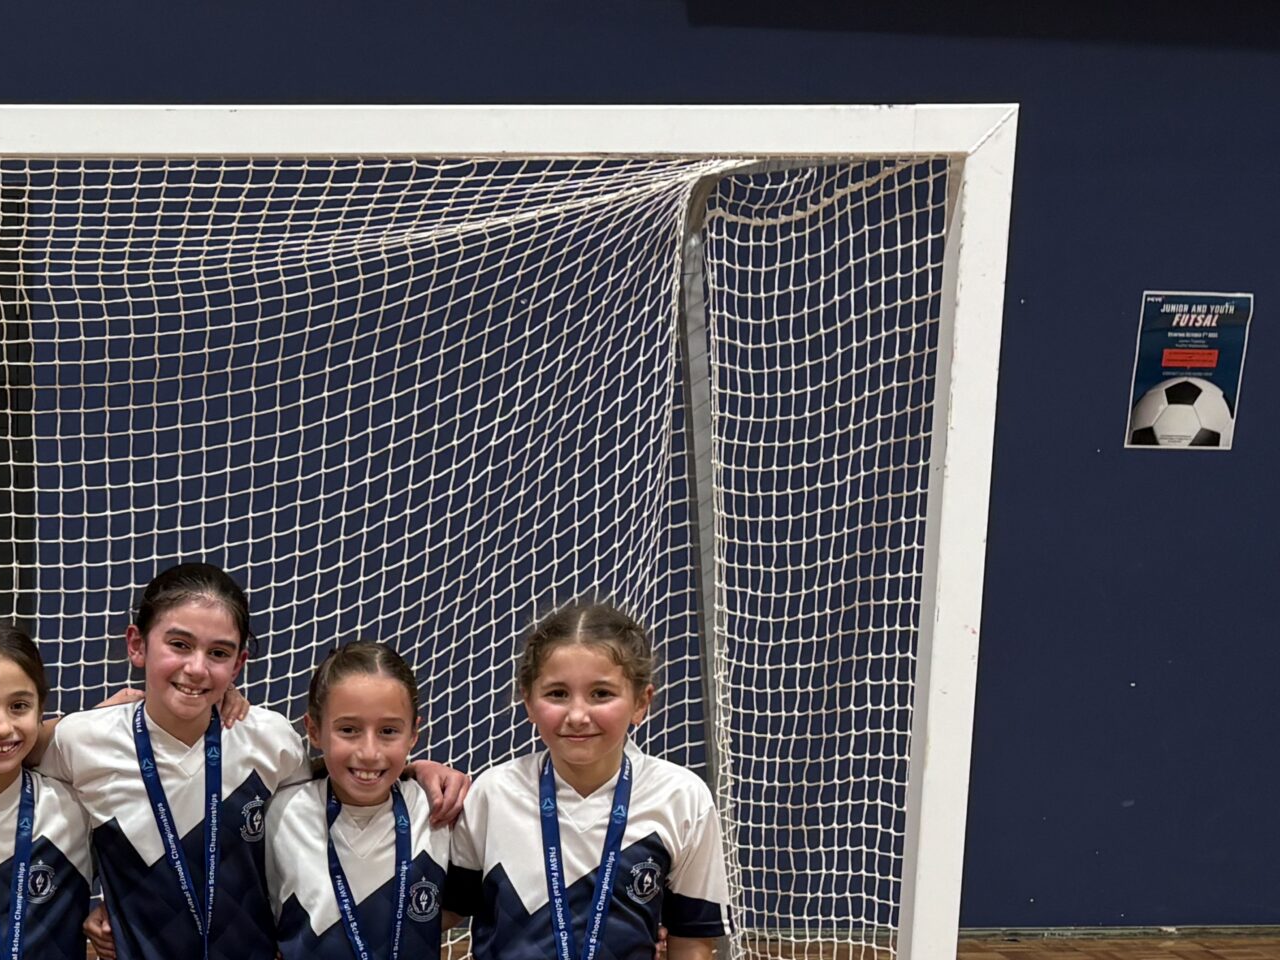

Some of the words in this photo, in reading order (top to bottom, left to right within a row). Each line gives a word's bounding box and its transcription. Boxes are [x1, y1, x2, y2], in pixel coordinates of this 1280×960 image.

[1160, 304, 1189, 313] JUNIOR
[1191, 305, 1207, 313] AND
[1210, 305, 1235, 314] YOUTH
[1172, 314, 1219, 327] FUTSAL
[157, 802, 179, 859] Championships
[209, 793, 218, 853] Championships
[208, 854, 216, 884] Schools
[549, 846, 559, 871] FNSW
[175, 860, 188, 890] Schools
[396, 860, 409, 919] Championships
[552, 871, 561, 897] Futsal
[14, 862, 26, 921] Championships
[590, 912, 602, 944] Schools
[596, 851, 615, 911] Championships
[555, 897, 566, 929] Schools
[11, 922, 21, 953] Schools
[350, 922, 364, 951] Schools
